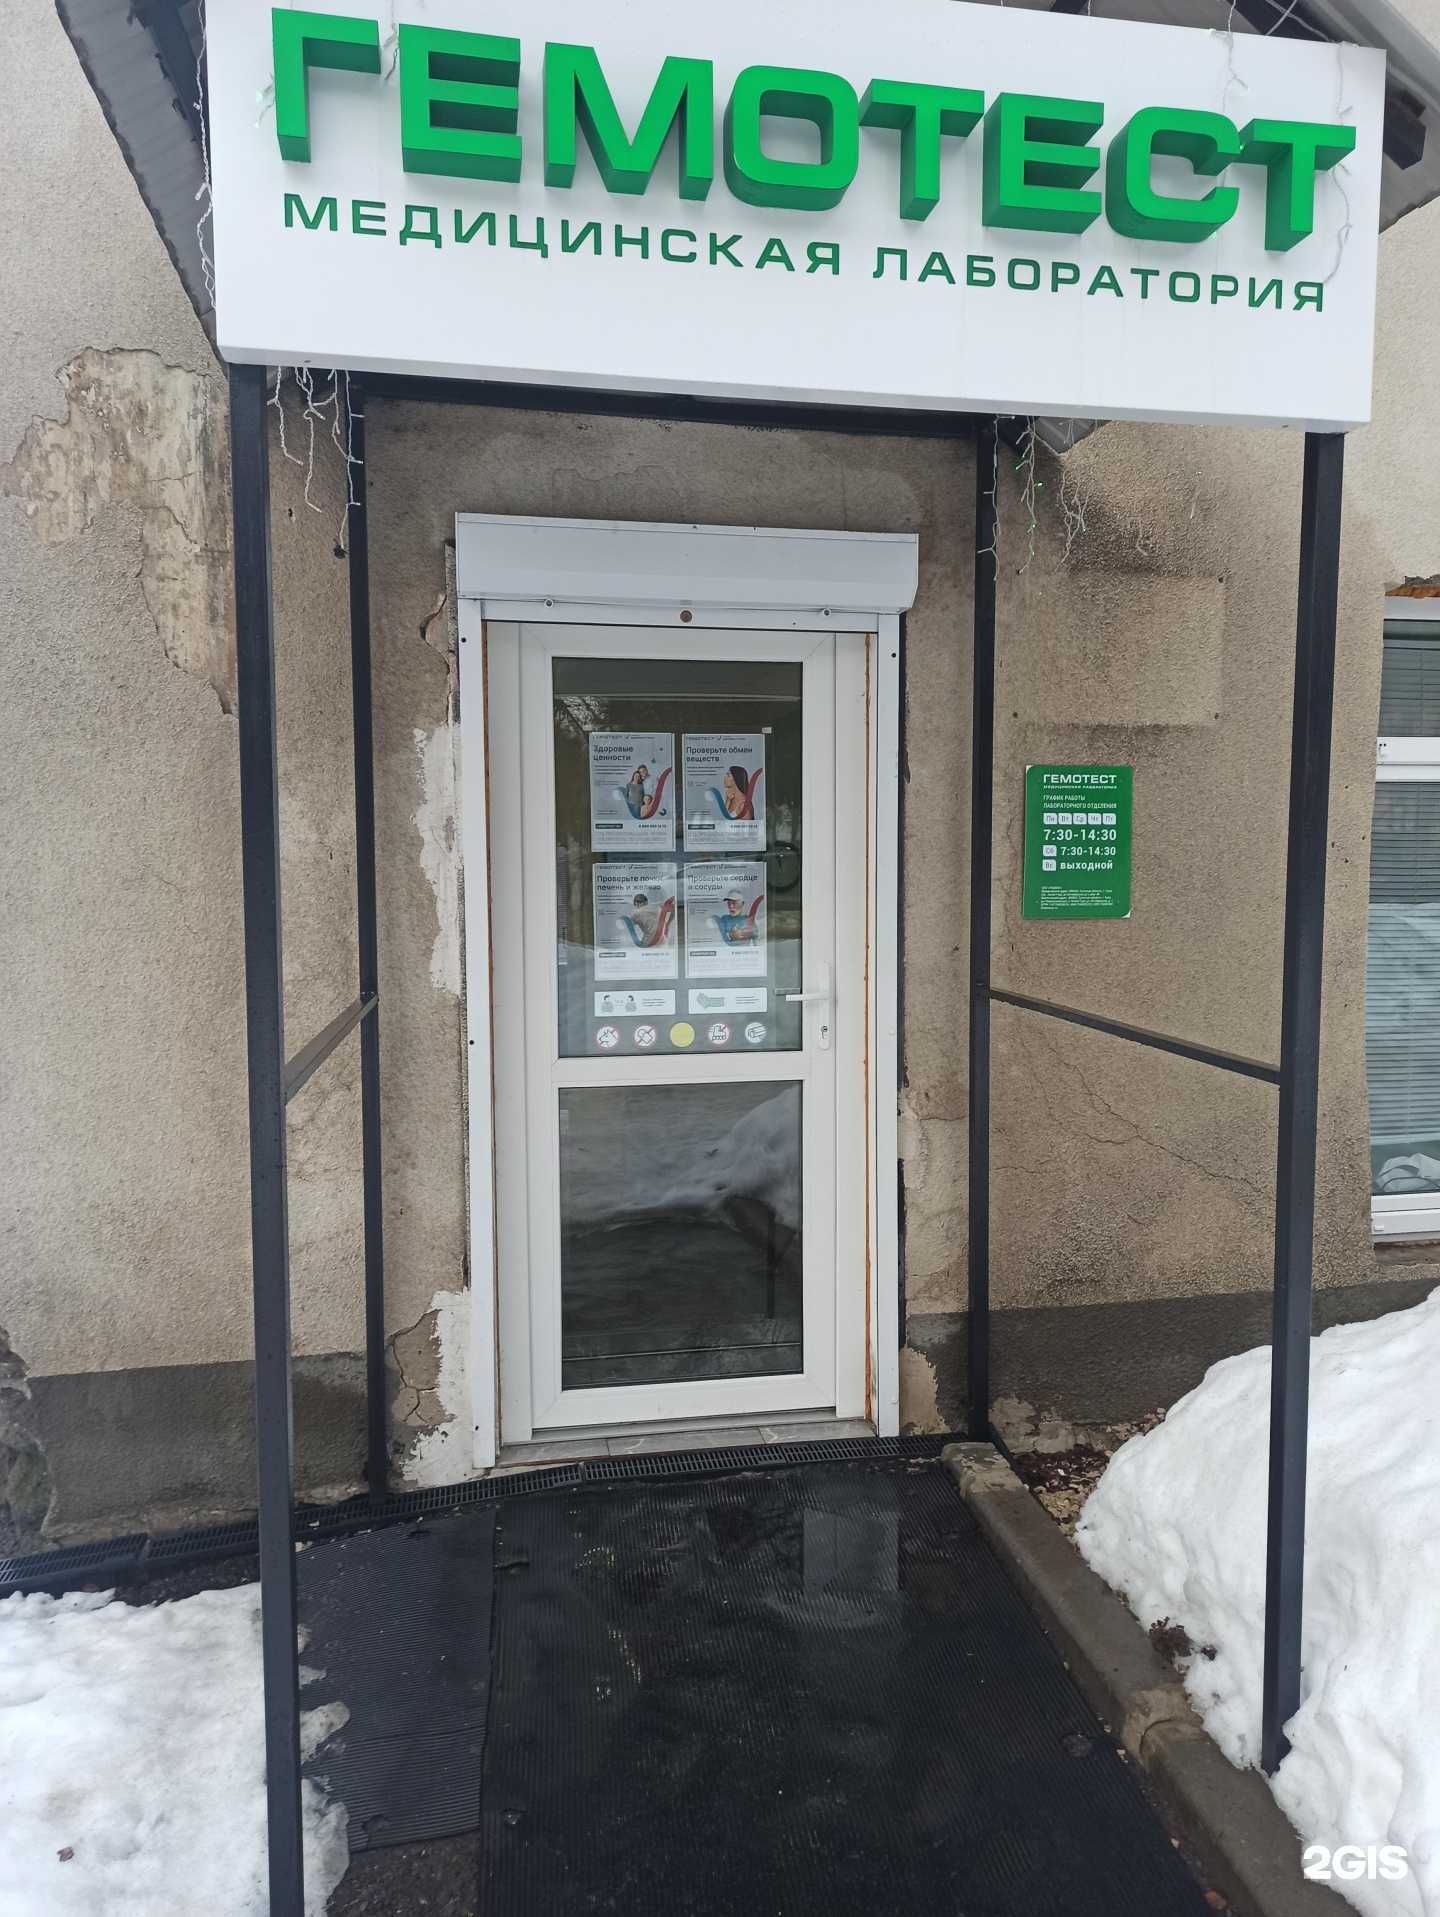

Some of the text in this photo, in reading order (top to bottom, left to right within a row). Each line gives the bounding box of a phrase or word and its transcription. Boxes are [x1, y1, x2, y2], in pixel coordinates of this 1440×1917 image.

[272, 8, 1356, 252] ГЕМОТЕСТ
[284, 193, 1325, 312] МЕДИЦИНСКАЯ ЛАБОРАТОРИЯ
[593, 745, 634, 754] Здоровые
[1043, 774, 1118, 784] ГЕМОТЕСТ
[1043, 829, 1117, 841] 7:30-14:30
[1061, 846, 1116, 856] 7:30-14:30
[1060, 859, 1113, 871] выходной
